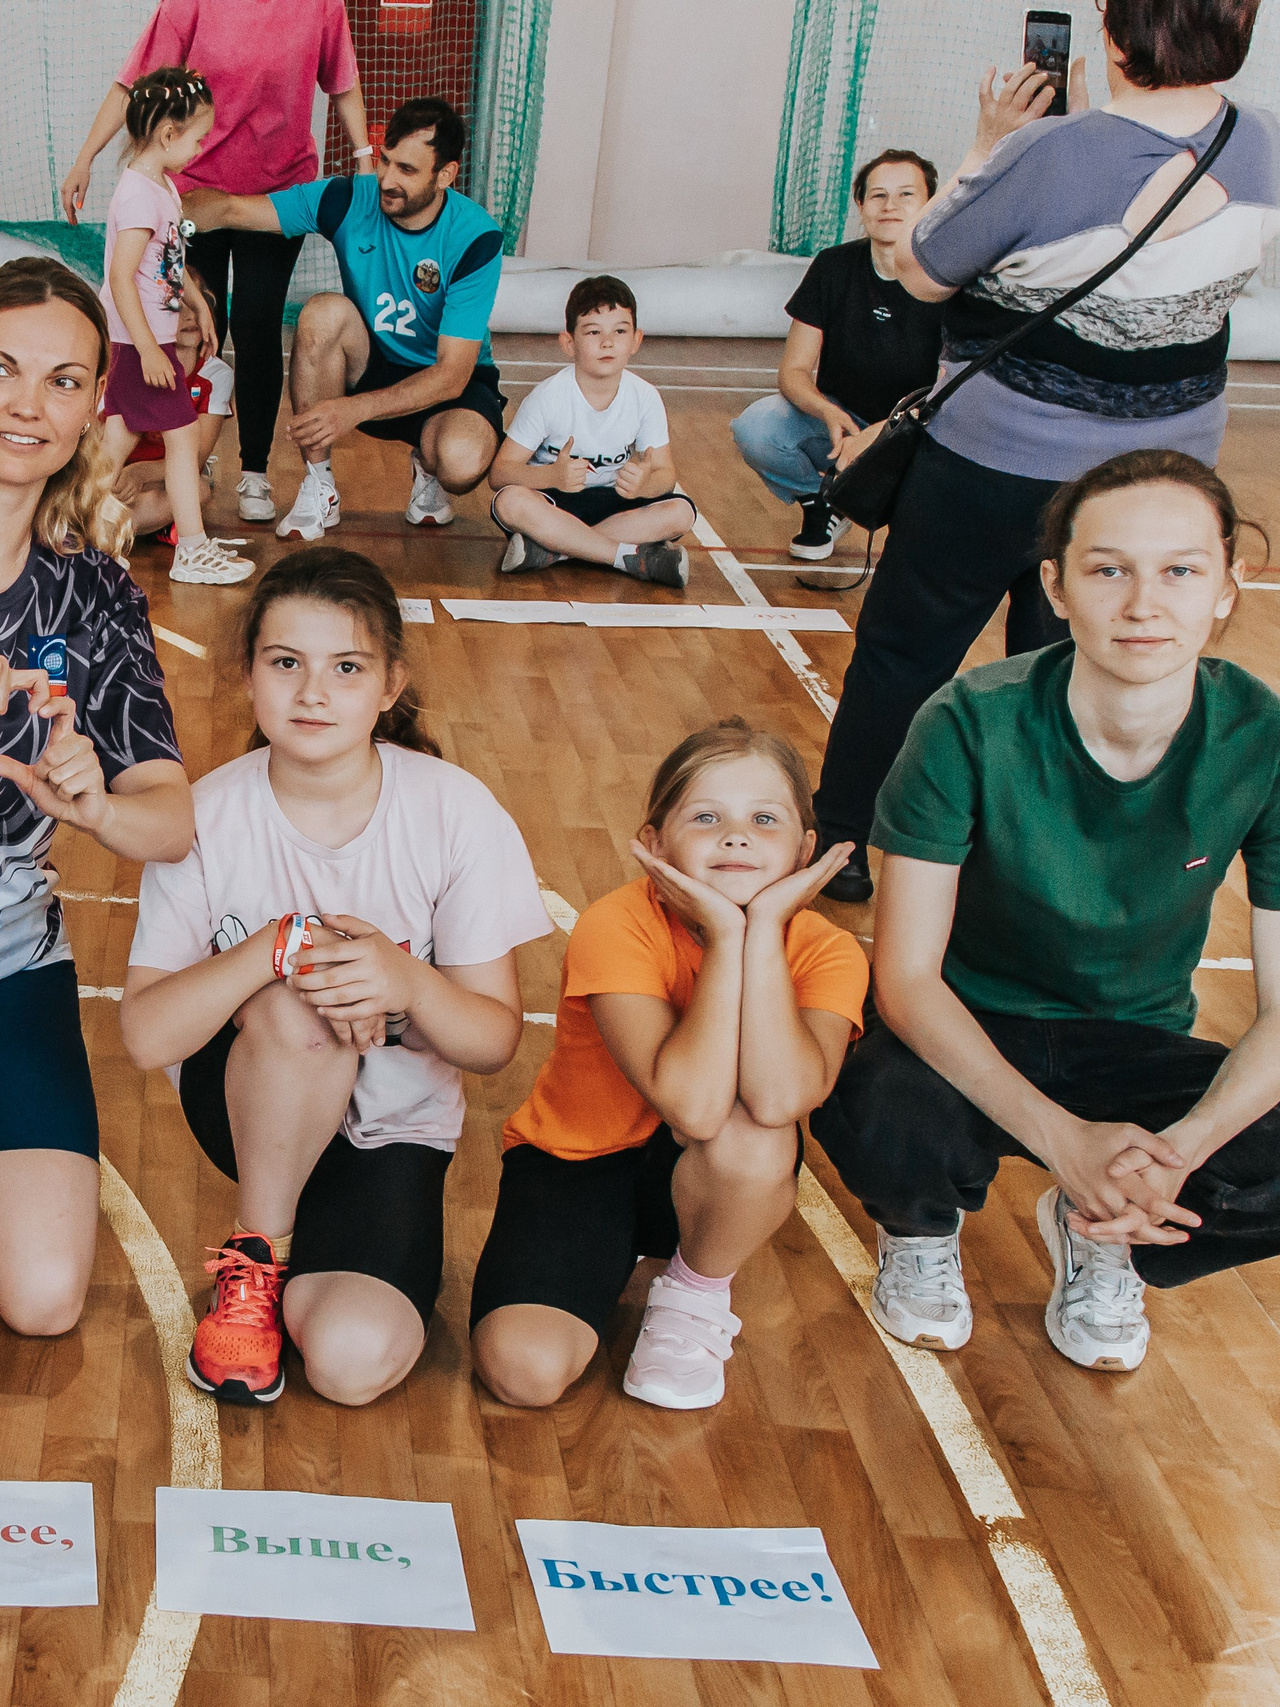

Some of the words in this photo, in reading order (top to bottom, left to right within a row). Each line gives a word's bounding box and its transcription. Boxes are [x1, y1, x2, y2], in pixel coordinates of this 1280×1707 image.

[374, 291, 417, 338] 22
[208, 1525, 412, 1569] Выше,
[538, 1557, 834, 1606] Быстрее!
